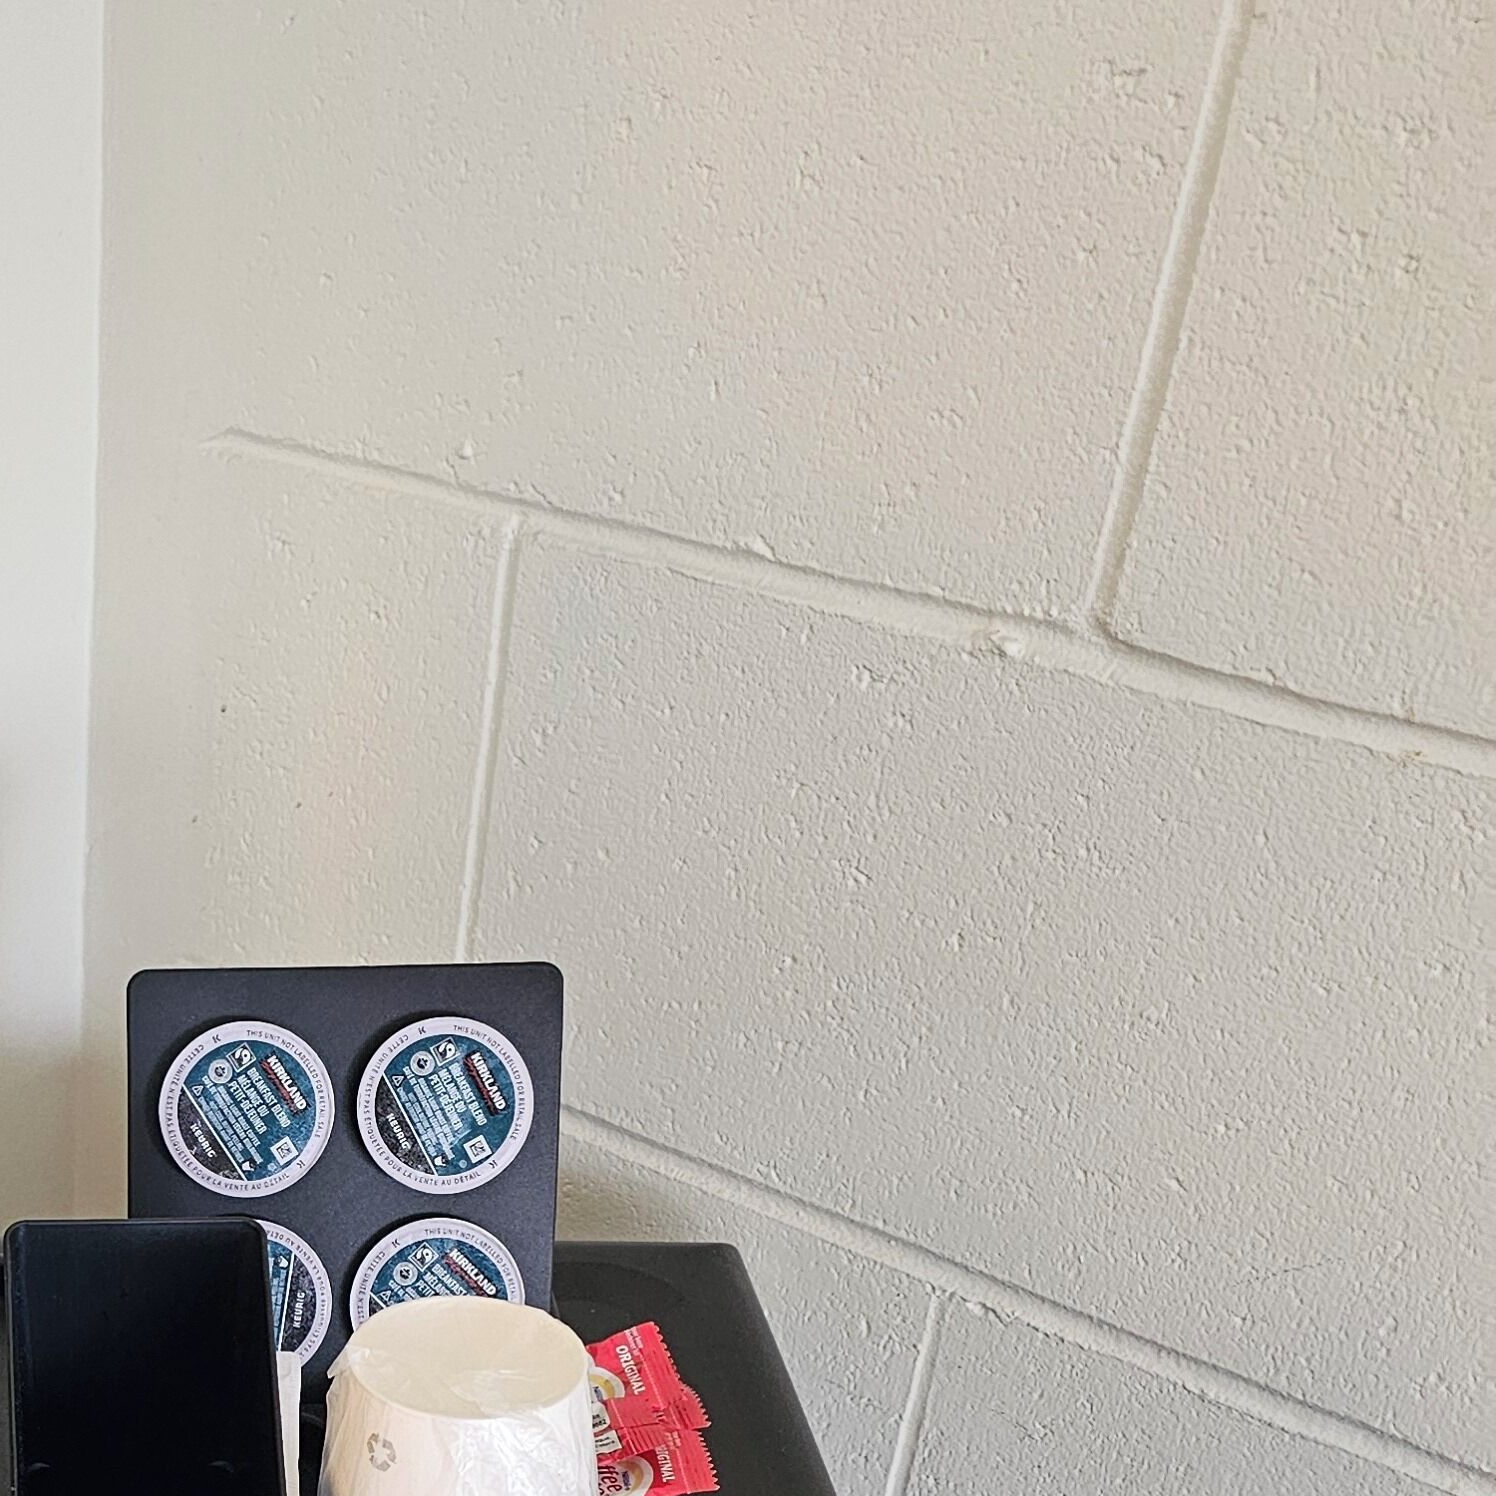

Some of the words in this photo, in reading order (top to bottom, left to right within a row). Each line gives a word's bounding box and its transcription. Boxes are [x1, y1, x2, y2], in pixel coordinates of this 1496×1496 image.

[246, 1029, 262, 1039] THIS
[281, 1039, 295, 1051] NOT
[293, 1047, 319, 1079] LABELLED
[453, 1024, 469, 1033] THIS
[486, 1036, 500, 1050] NOT
[498, 1048, 522, 1081] LABELLED
[246, 1066, 277, 1107] BREAKFAST
[270, 1103, 291, 1128] BLEND
[266, 1054, 308, 1111] KIRKLAND
[447, 1062, 476, 1103] BREAKFAST
[467, 1100, 488, 1126] BLEND
[468, 1051, 508, 1110] KIRKLAND
[190, 1123, 217, 1158] KEURIG
[386, 1113, 410, 1150] KEURIG
[224, 1181, 248, 1192] VENTE
[251, 1182, 261, 1190] AU
[383, 1155, 402, 1173] POUR
[402, 1169, 413, 1180] LA
[441, 1178, 452, 1186] AU
[422, 1269, 452, 1297] MÉLANG
[431, 1262, 466, 1299] BREAKFAST
[449, 1246, 497, 1297] KIRKLAND
[293, 1292, 305, 1328] KEURIG
[616, 1344, 647, 1396] ORIGINAL
[598, 1464, 623, 1493] ffee
[656, 1445, 676, 1483] IGINAL
